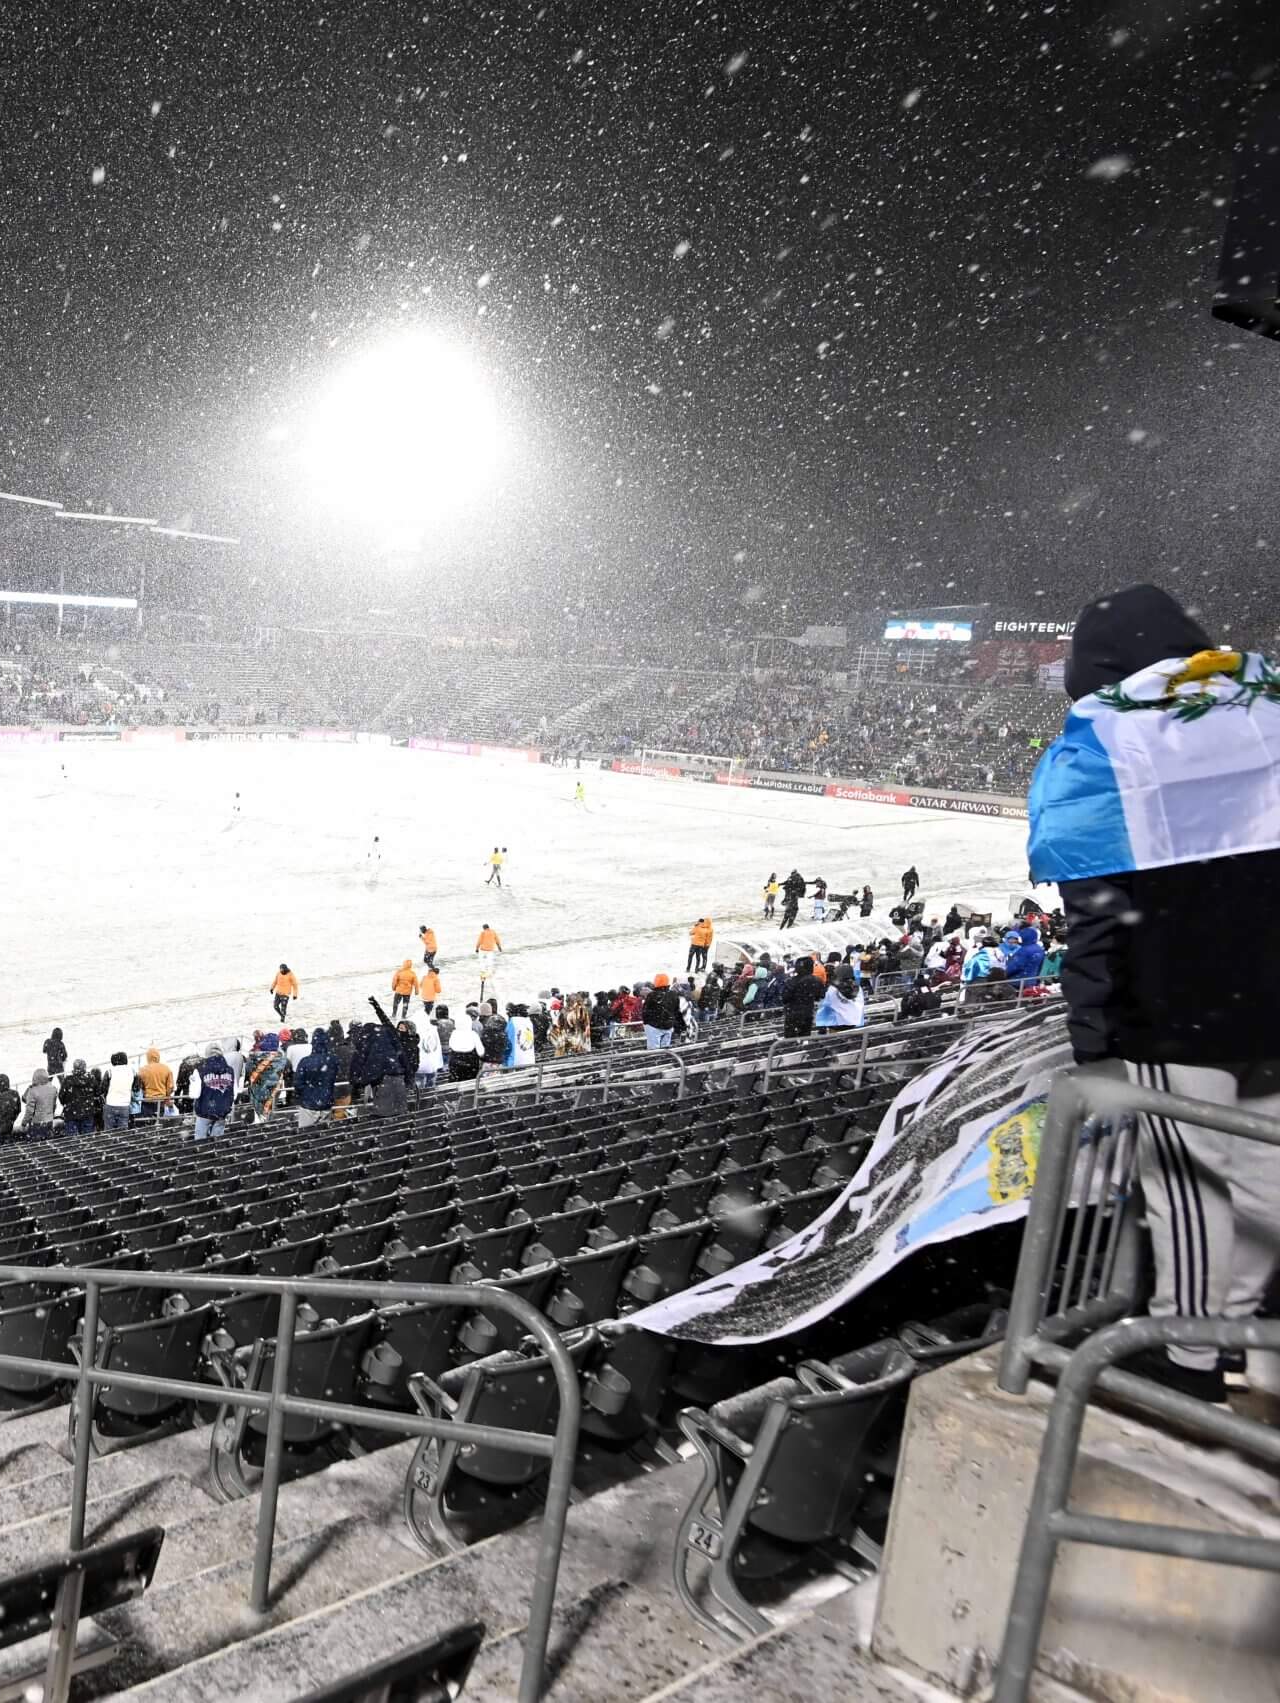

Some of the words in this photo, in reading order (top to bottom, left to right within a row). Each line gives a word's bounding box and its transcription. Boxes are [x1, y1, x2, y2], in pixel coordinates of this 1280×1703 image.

[748, 777, 793, 790] CHAMPIONS
[793, 784, 823, 795] LEAGUE
[835, 787, 897, 804] Scotiabank
[909, 795, 948, 810] QATAR
[949, 800, 1000, 816] AIRWAYS
[416, 1471, 431, 1489] 23
[694, 1528, 712, 1550] 24
